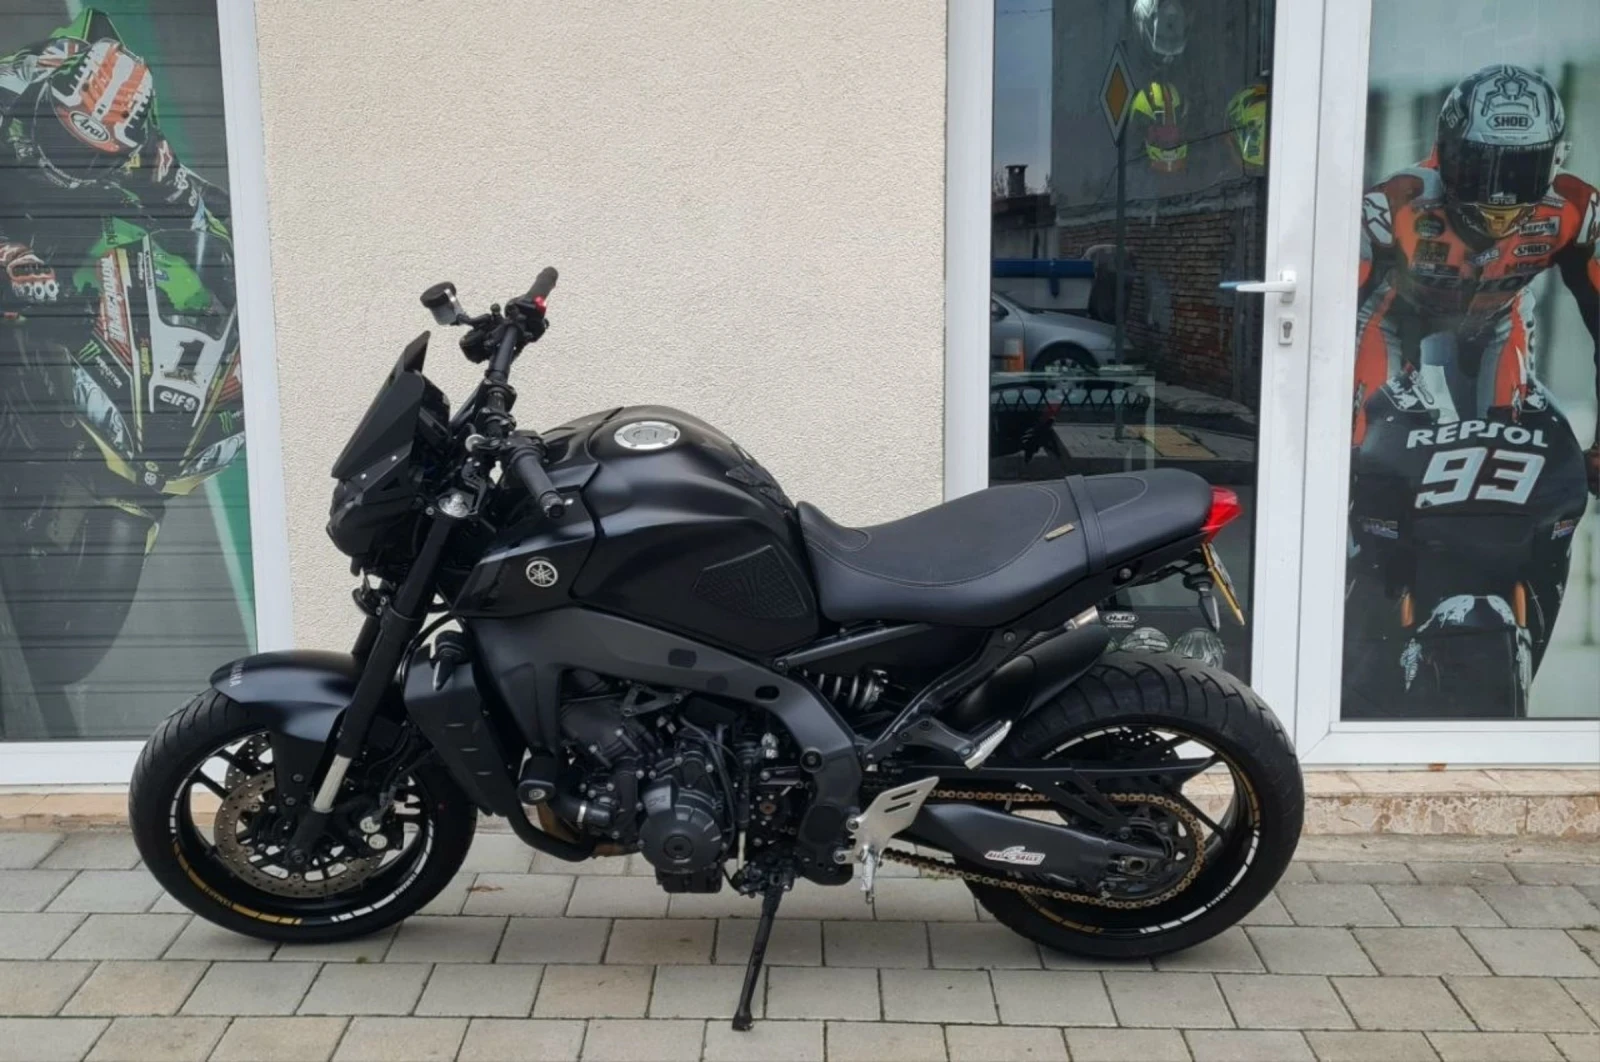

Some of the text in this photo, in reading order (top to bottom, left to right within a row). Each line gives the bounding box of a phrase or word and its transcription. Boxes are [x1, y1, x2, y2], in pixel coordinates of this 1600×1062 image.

[75, 115, 105, 140] Arai
[1494, 116, 1529, 128] SHOEI
[1406, 420, 1549, 449] REPSOL
[1414, 446, 1546, 510] 93
